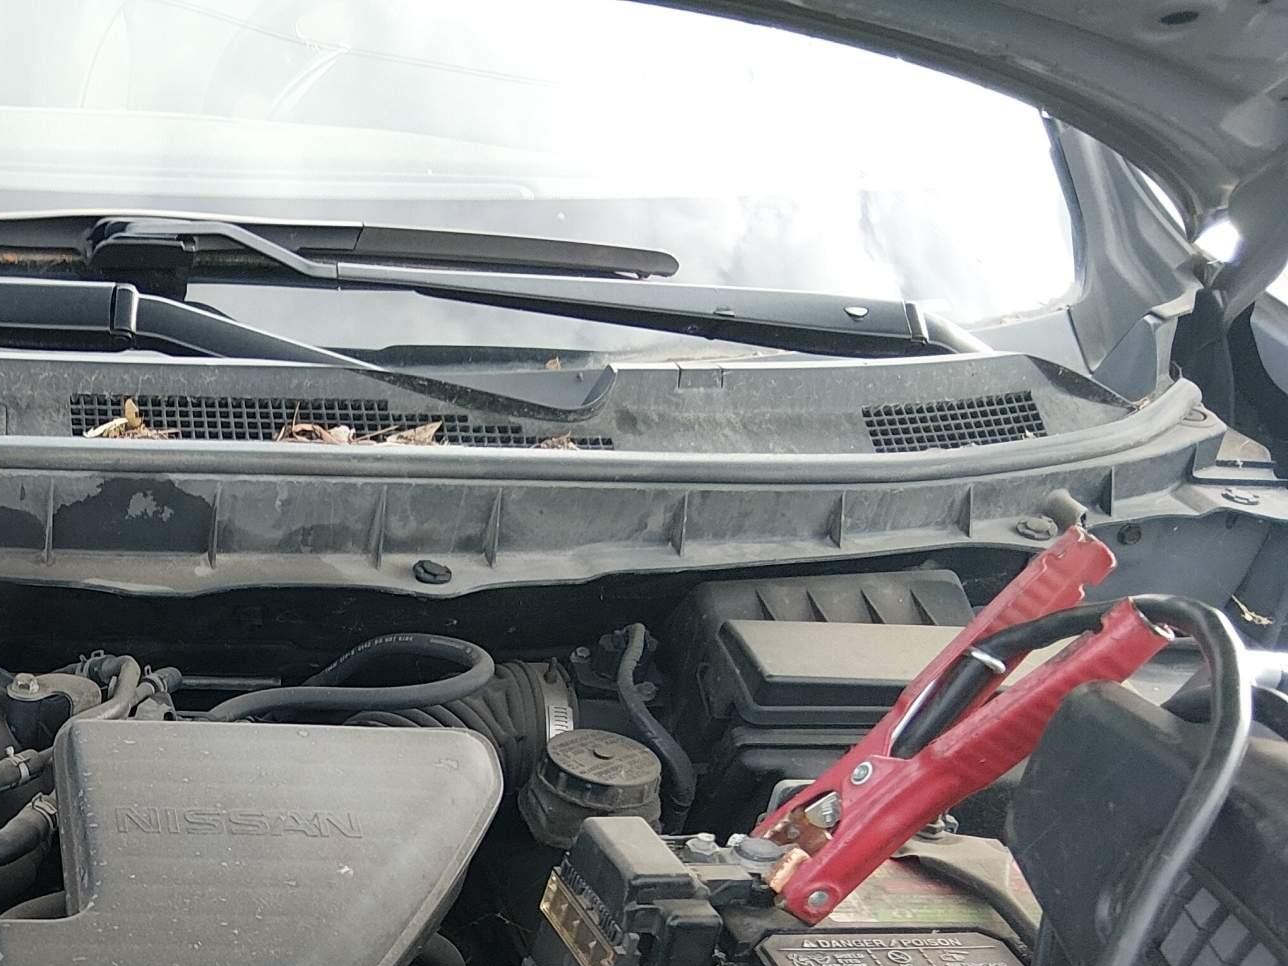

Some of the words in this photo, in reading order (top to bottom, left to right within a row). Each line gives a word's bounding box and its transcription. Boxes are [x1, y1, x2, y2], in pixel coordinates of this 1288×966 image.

[115, 806, 364, 839] NISSAN
[816, 939, 886, 949] DANGER
[902, 938, 963, 947] POISON
